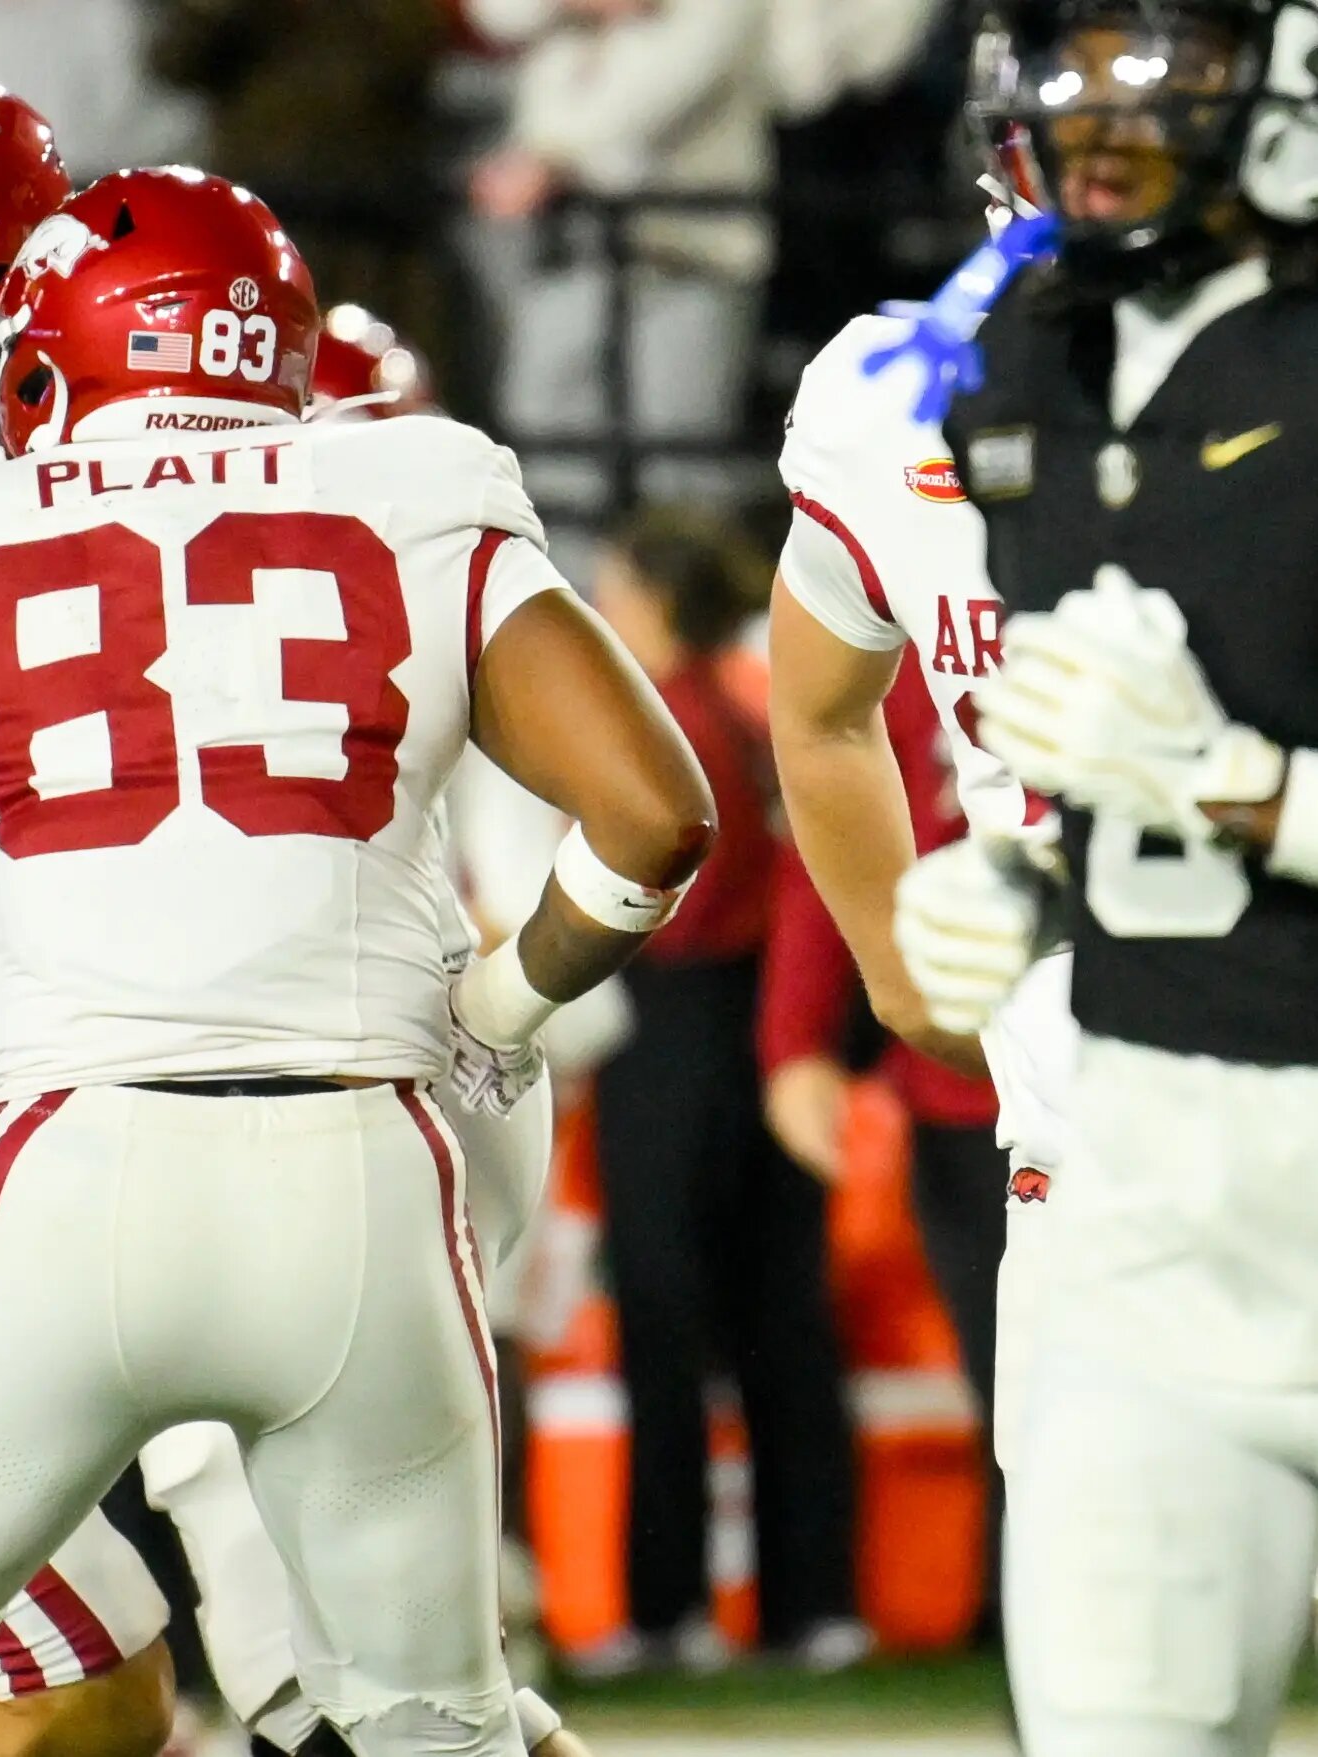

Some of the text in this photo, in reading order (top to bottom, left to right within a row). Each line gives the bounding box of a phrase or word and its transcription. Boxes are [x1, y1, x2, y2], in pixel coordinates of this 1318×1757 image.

[232, 279, 256, 308] SEC
[199, 308, 277, 383] 83
[146, 412, 273, 432] RAZORB
[36, 441, 294, 509] PLATT
[904, 467, 944, 490] Tyson
